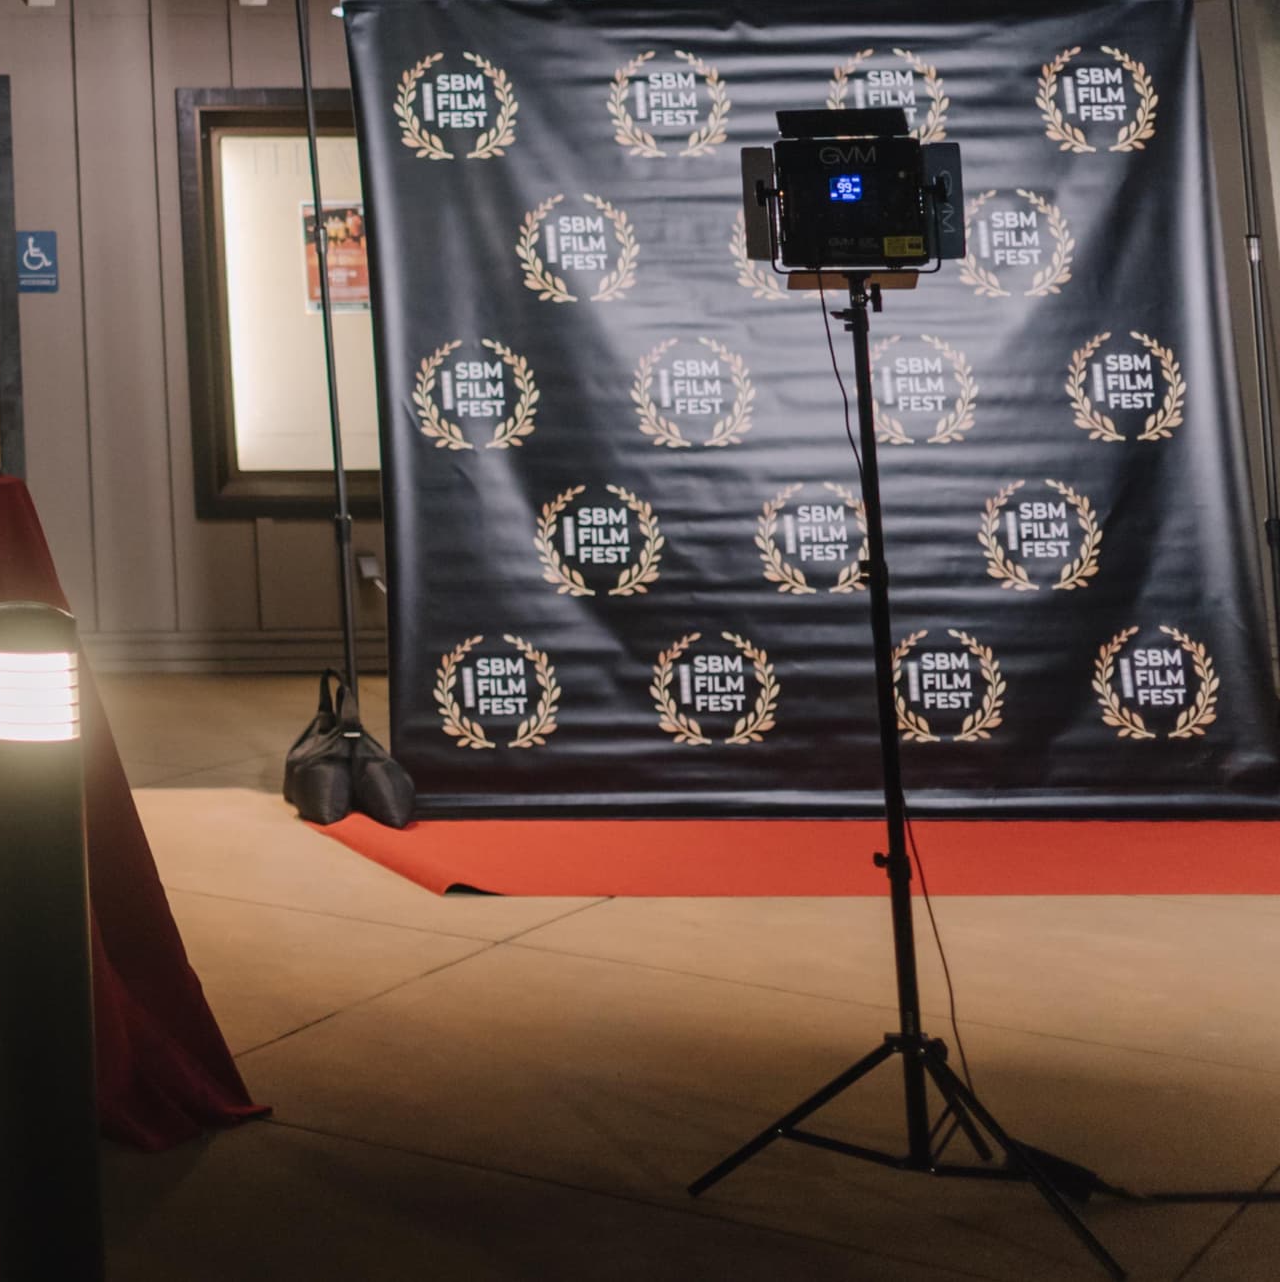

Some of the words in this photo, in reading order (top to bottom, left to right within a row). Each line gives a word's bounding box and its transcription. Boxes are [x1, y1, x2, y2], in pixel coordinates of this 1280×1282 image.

[436, 74, 484, 90] SBM
[649, 73, 695, 89] SBM
[867, 71, 913, 87] SBM
[1077, 68, 1122, 84] SBM
[437, 93, 486, 109] FILM
[649, 92, 697, 108] FILM
[868, 90, 915, 106] FILM
[1078, 87, 1125, 103] FILM
[438, 112, 487, 128] FEST
[651, 110, 698, 126] FEST
[1080, 105, 1126, 121] FEST
[819, 145, 877, 164] GVM
[837, 182, 853, 193] 99
[560, 217, 604, 232] SBM
[992, 212, 1037, 227] SBM
[560, 235, 606, 251] FILM
[993, 230, 1039, 246] FILM
[561, 254, 608, 270] FEST
[995, 249, 1041, 265] FEST
[456, 362, 502, 379] SBM
[673, 360, 719, 377] SBM
[895, 358, 941, 374] SBM
[1106, 355, 1151, 371] SBM
[456, 381, 504, 398] FILM
[674, 379, 721, 395] FILM
[897, 376, 944, 392] FILM
[1107, 374, 1153, 390] FILM
[458, 400, 505, 416] FEST
[676, 398, 722, 414] FEST
[898, 395, 945, 411] FEST
[1109, 392, 1155, 409] FEST
[578, 509, 627, 525] SBM
[798, 506, 844, 522] SBM
[1020, 503, 1066, 519] SBM
[579, 528, 629, 544] FILM
[799, 526, 847, 542] FILM
[1021, 522, 1068, 538] FILM
[580, 547, 630, 563] FEST
[801, 545, 848, 561] FEST
[1022, 541, 1070, 557] FEST
[694, 656, 742, 673] SBM
[921, 653, 969, 670] SBM
[1134, 649, 1182, 666] SBM
[477, 658, 524, 675] SBM
[695, 676, 744, 693] FILM
[923, 673, 971, 689] FILM
[1135, 670, 1184, 686] FILM
[478, 679, 526, 695] FILM
[696, 695, 745, 711] FEST
[924, 692, 972, 709] FEST
[1137, 689, 1186, 705] FEST
[479, 698, 528, 714] FEST
